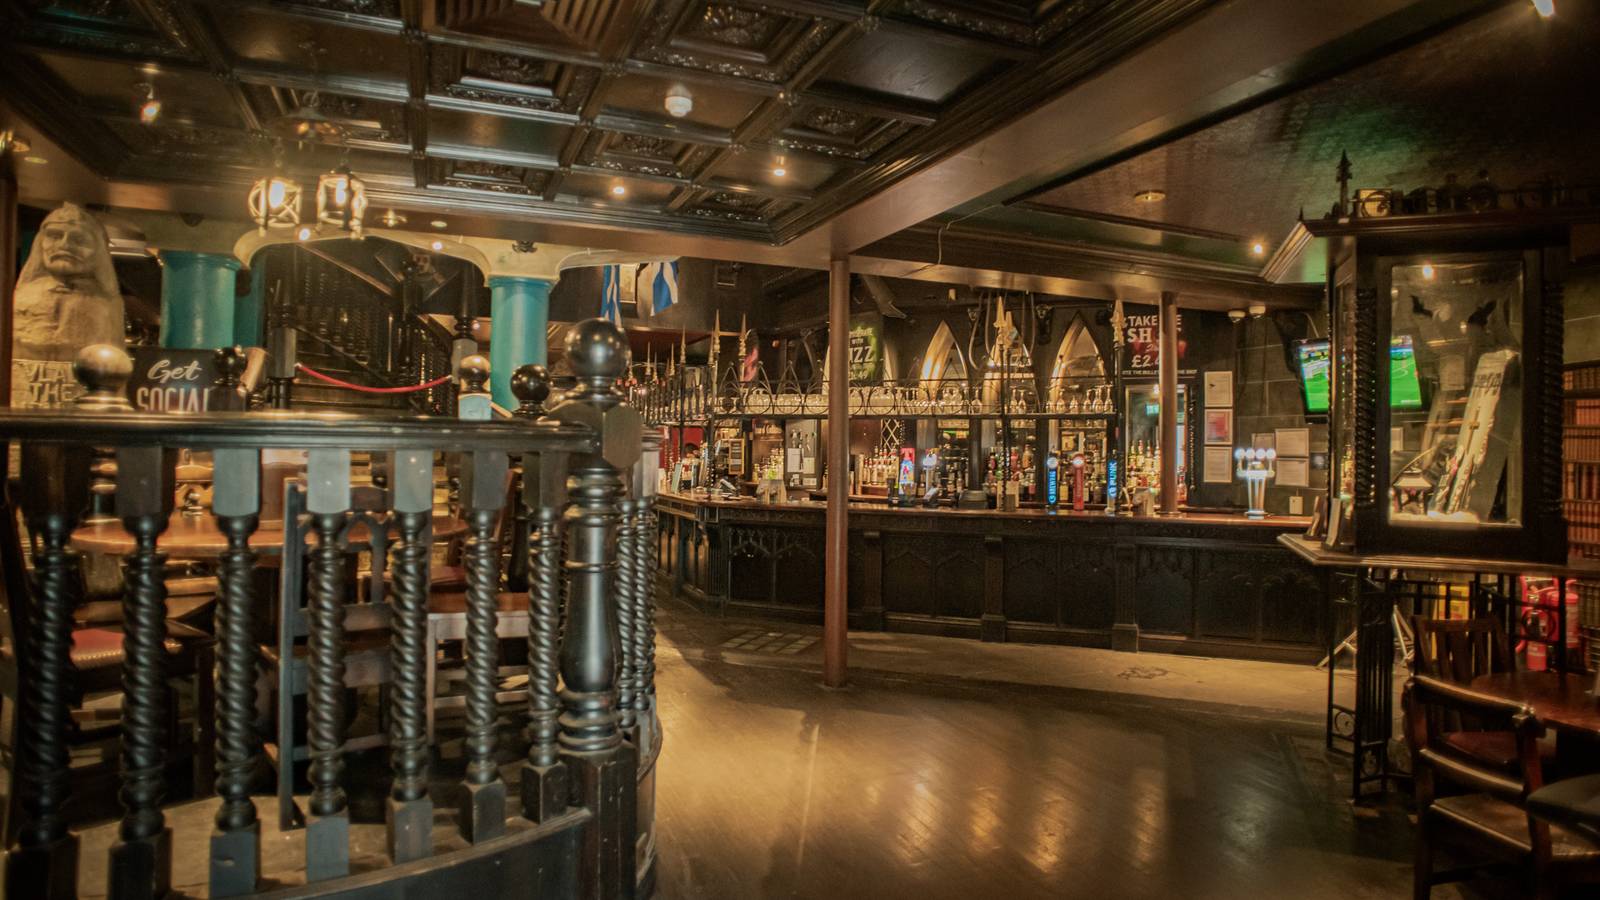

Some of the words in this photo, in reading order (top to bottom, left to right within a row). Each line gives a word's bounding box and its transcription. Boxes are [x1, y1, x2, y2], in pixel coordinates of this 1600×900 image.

[1127, 315, 1158, 327] TAKE
[147, 360, 202, 383] Get
[1109, 461, 1117, 485] PUNK
